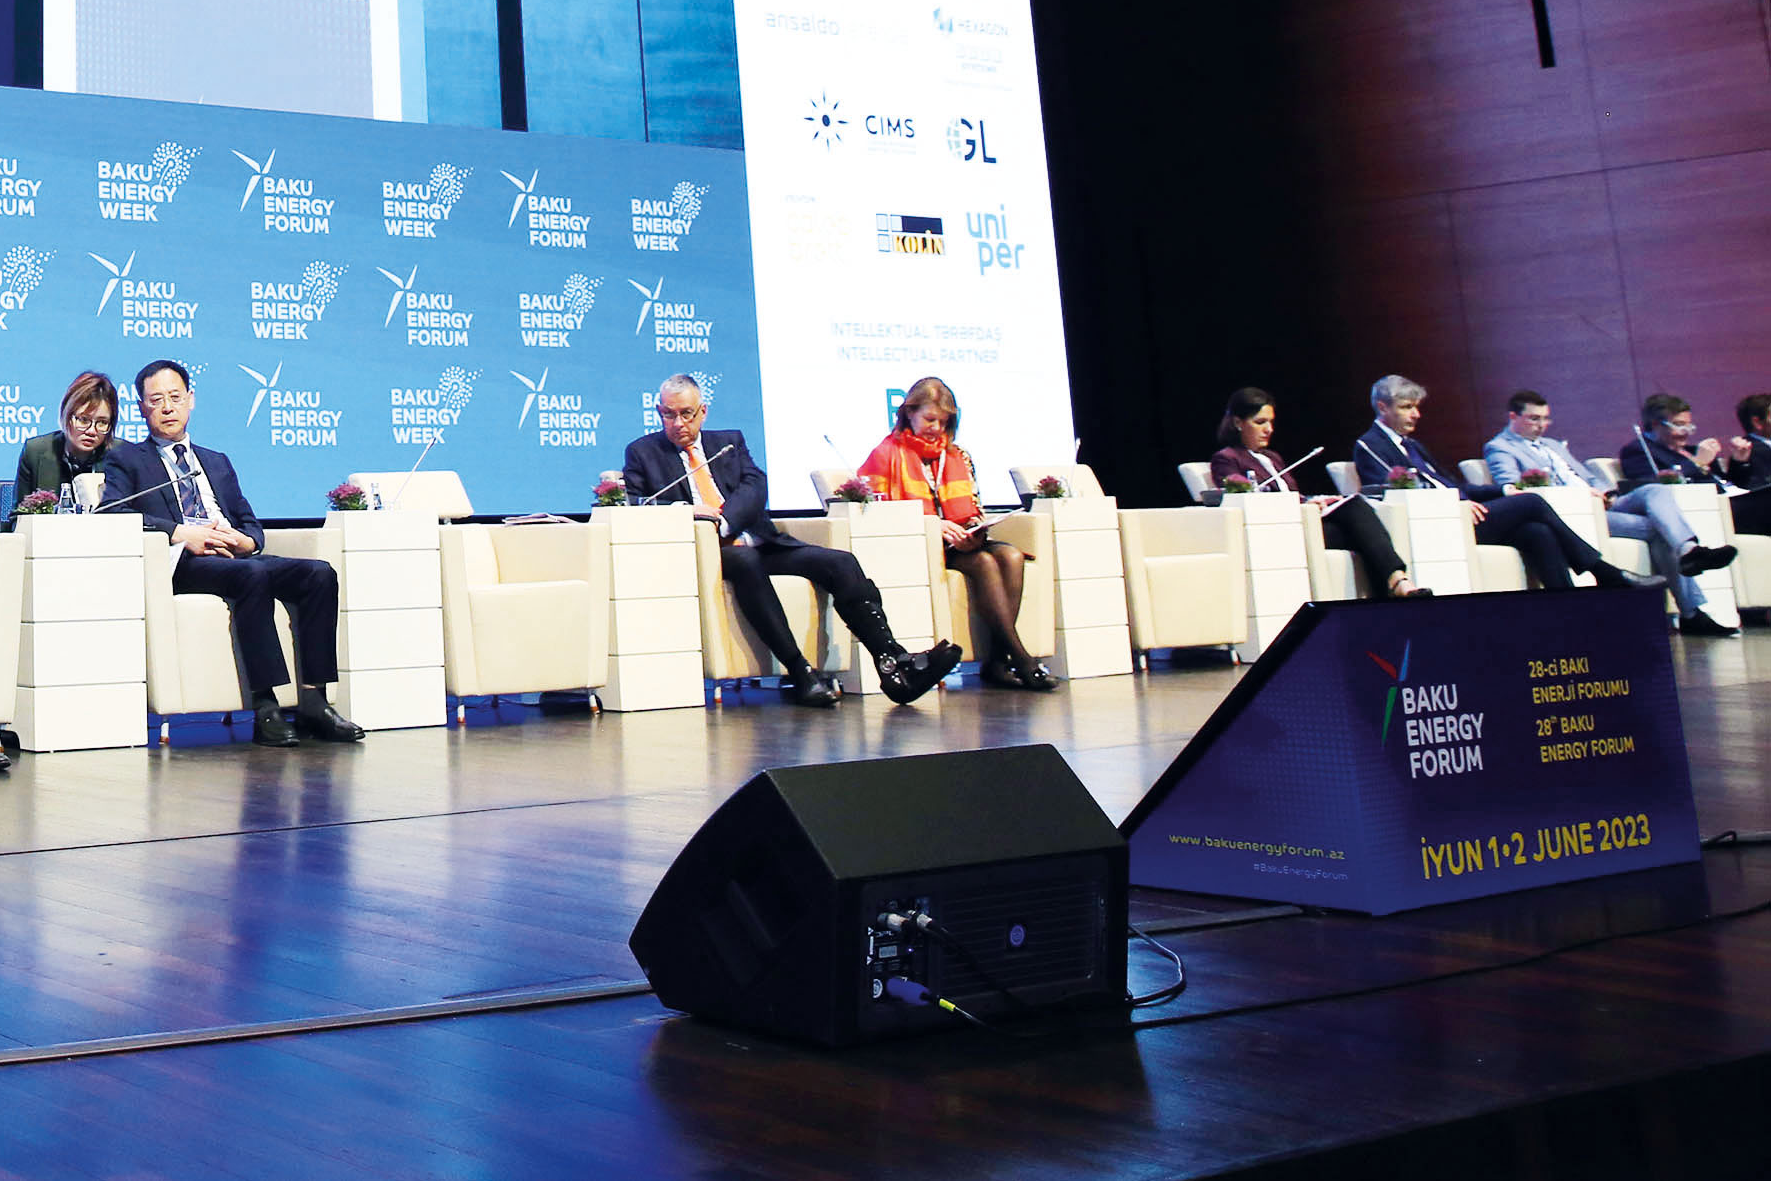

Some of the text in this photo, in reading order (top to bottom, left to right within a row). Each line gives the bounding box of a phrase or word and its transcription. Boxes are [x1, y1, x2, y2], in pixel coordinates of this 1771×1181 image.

[866, 115, 915, 138] CIMS
[98, 161, 153, 181] BAKU
[98, 181, 177, 203] ENERGY
[264, 176, 313, 195] BAKU
[383, 181, 430, 200] BAKU
[98, 202, 157, 222] WEEK
[264, 196, 334, 215] ENERGY
[383, 200, 451, 220] ENERGY
[529, 195, 572, 212] BAKU
[631, 199, 673, 216] BAKU
[265, 215, 329, 234] FORUM
[385, 219, 436, 237] WEEK
[530, 213, 590, 230] ENERGY
[632, 216, 691, 235] ENERGY
[966, 204, 1007, 240] uni
[530, 230, 586, 248] FORUM
[634, 234, 679, 251] WEEK
[977, 241, 1025, 276] per
[122, 280, 175, 298] BAKU
[251, 282, 302, 300] BAKU
[122, 299, 198, 319] ENERGY
[407, 292, 453, 310] BAKU
[519, 293, 565, 311] BAKU
[653, 302, 694, 318] BAKU
[251, 302, 325, 321] ENERGY
[407, 311, 473, 328] ENERGY
[520, 312, 584, 329] ENERGY
[122, 320, 193, 338] FORUM
[253, 321, 308, 339] WEEK
[408, 328, 468, 346] FORUM
[655, 320, 712, 336] ENERGY
[521, 330, 570, 347] WEEK
[656, 336, 709, 353] FORUM
[270, 390, 320, 408] BAKU
[391, 388, 439, 406] BAKU
[538, 395, 582, 411] BAKU
[271, 410, 341, 427] ENERGY
[392, 408, 460, 426] ENERGY
[539, 412, 600, 429] ENERGY
[271, 429, 337, 446] FORUM
[393, 426, 445, 444] WEEK
[539, 430, 596, 446] FORUM
[1528, 657, 1589, 678] 28-ci BAKI
[1402, 683, 1457, 714] BAKU
[1532, 680, 1630, 704] ENERJİ FORUMU
[1405, 713, 1484, 746] ENERGY
[1560, 715, 1595, 734] BAKU
[1540, 736, 1635, 763] ENERGY FORUM
[1409, 745, 1483, 779] FORUM
[1169, 834, 1345, 860] www.bakuenergyforum.az
[1420, 836, 1484, 880] İYUN
[1533, 822, 1594, 862] JUNE
[1597, 813, 1652, 851] 2023
